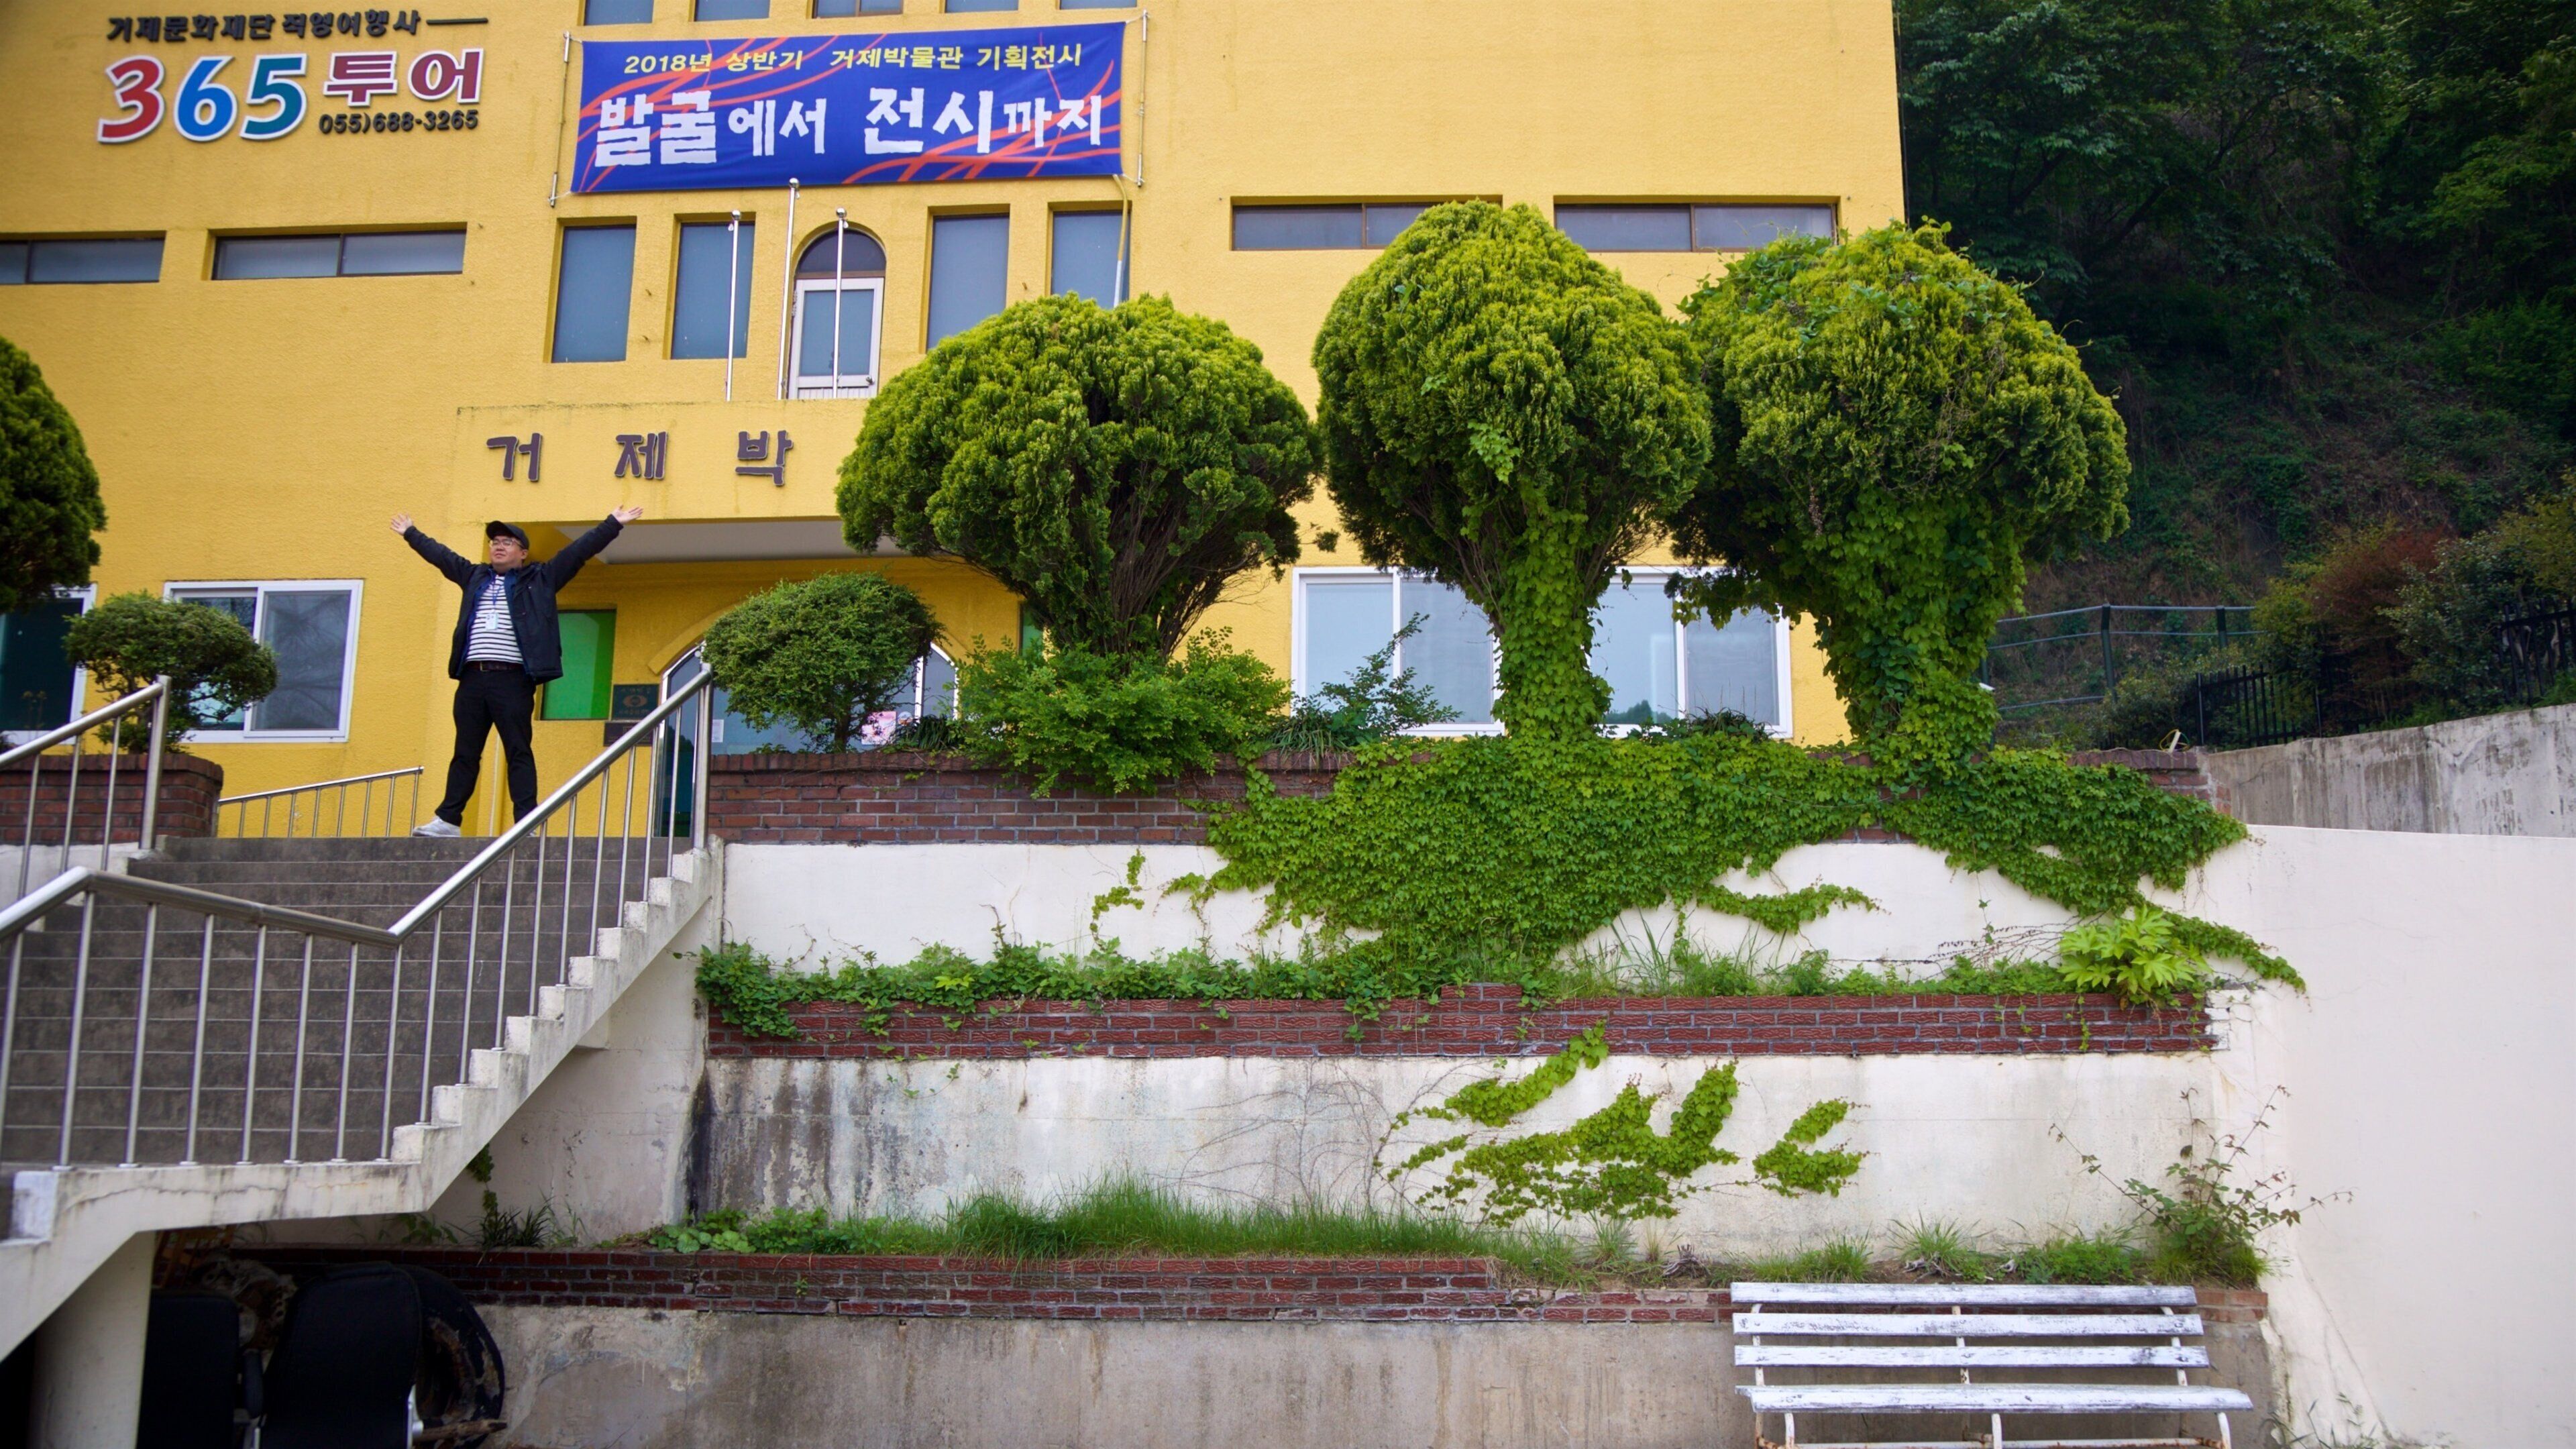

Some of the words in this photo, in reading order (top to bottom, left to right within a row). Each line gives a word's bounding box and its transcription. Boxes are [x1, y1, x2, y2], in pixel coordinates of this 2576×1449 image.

[107, 14, 276, 42] 거제문화재단
[625, 53, 712, 74] 2018년
[725, 50, 802, 72] 상반기
[830, 46, 964, 70] 거제박물관
[977, 44, 1082, 70] 기획전시
[97, 54, 307, 143] 365
[323, 48, 484, 107] 투어
[319, 109, 478, 134] 055)688-3265
[594, 91, 825, 166] 발굴에서
[864, 87, 1102, 154] 전시까지
